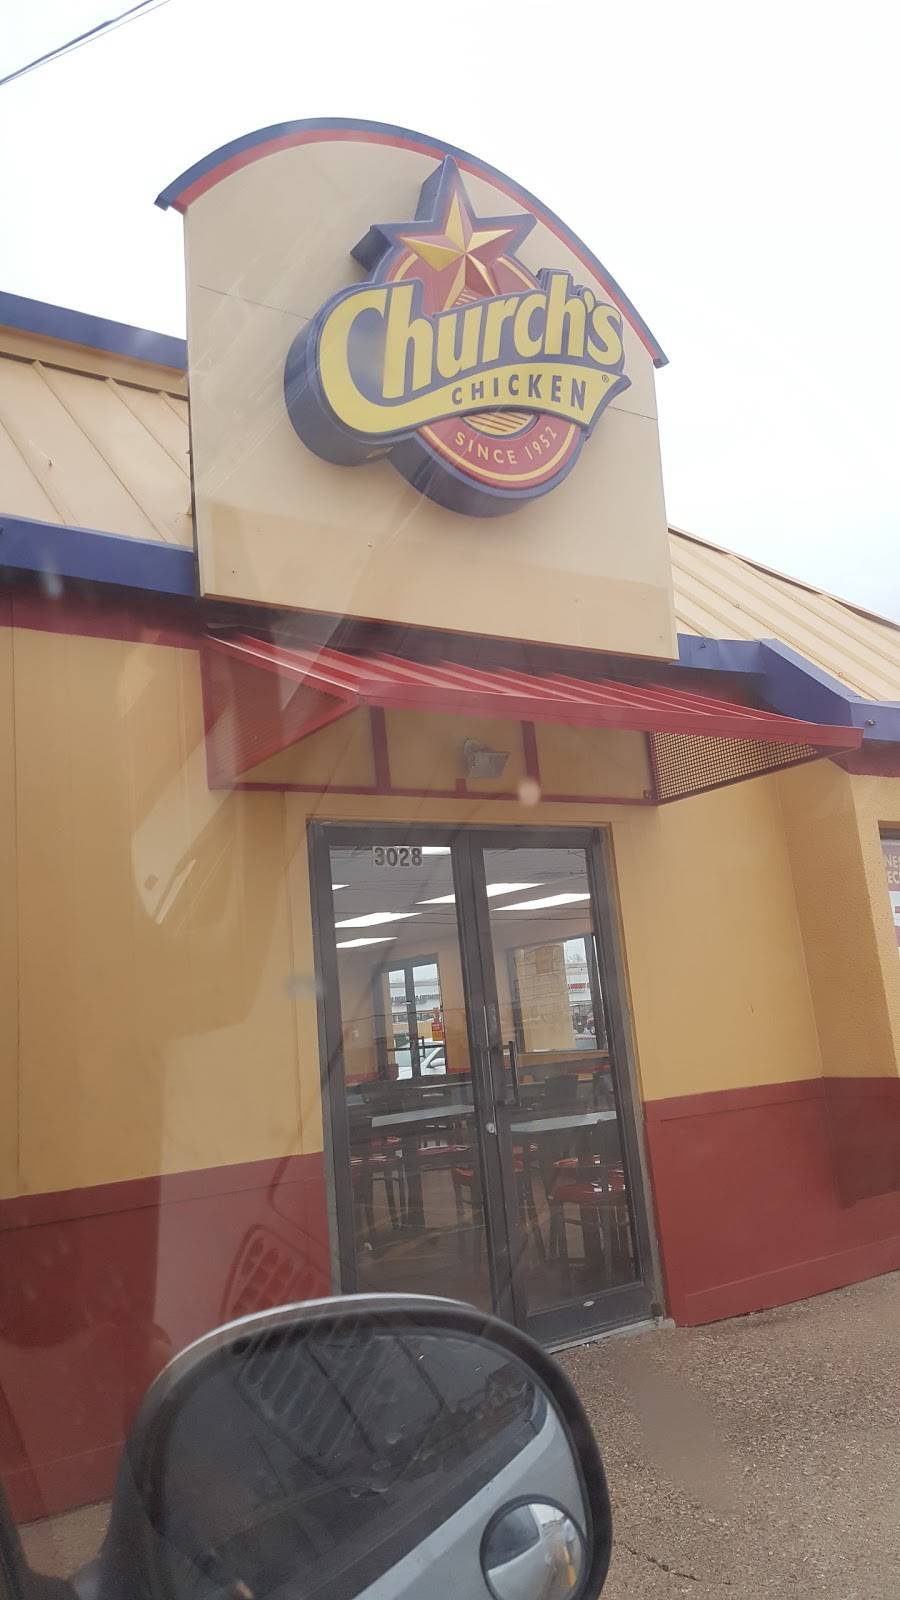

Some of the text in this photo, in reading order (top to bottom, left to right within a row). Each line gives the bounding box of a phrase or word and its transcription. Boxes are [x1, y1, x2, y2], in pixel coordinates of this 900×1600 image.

[319, 273, 623, 434] Church's
[451, 374, 587, 411] CHICKEN
[455, 426, 557, 465] SINCE 1952
[374, 847, 422, 867] 3028
